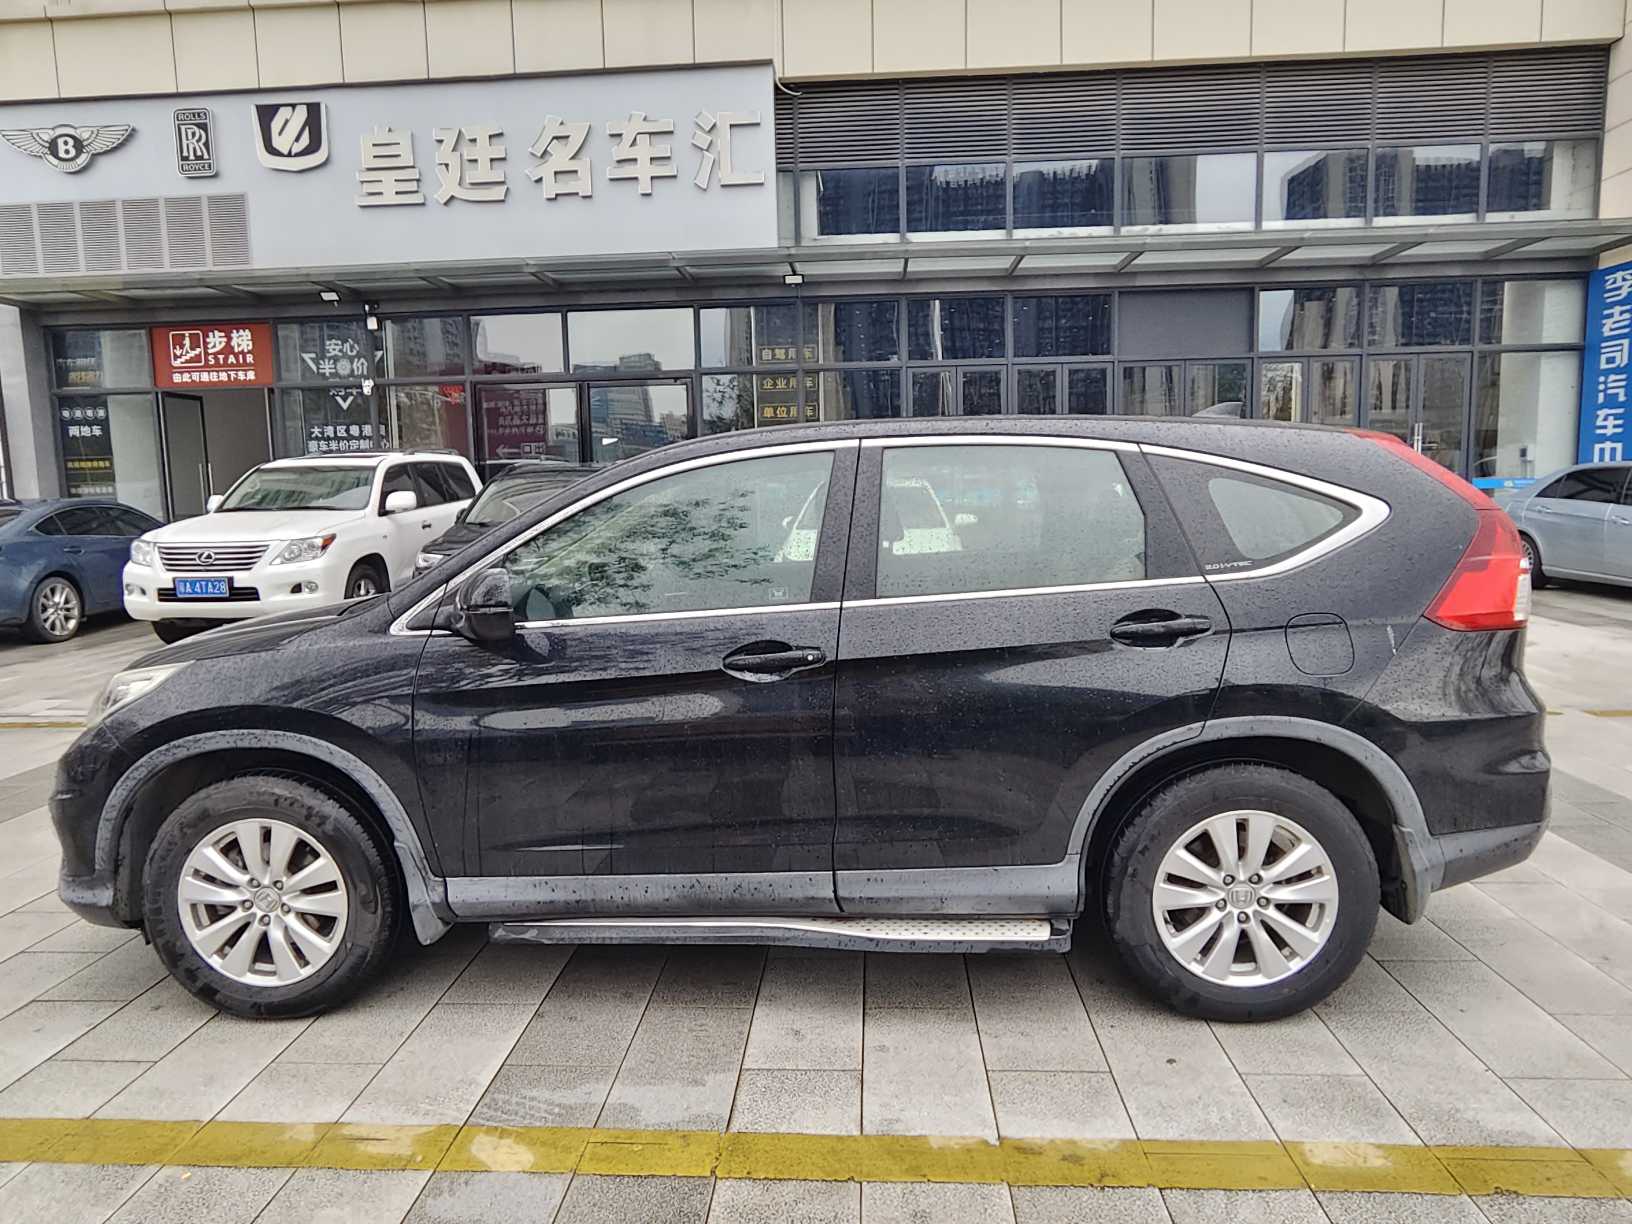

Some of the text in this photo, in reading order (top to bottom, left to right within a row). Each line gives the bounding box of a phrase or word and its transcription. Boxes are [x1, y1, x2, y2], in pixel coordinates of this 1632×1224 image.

[178, 111, 206, 121] ROLLS
[182, 163, 210, 171] ROYCE
[356, 108, 765, 207] 皇廷名车汇
[206, 328, 253, 354] 步梯
[325, 338, 359, 357] 安心
[208, 354, 254, 365] STAIR
[318, 357, 368, 376] 半价
